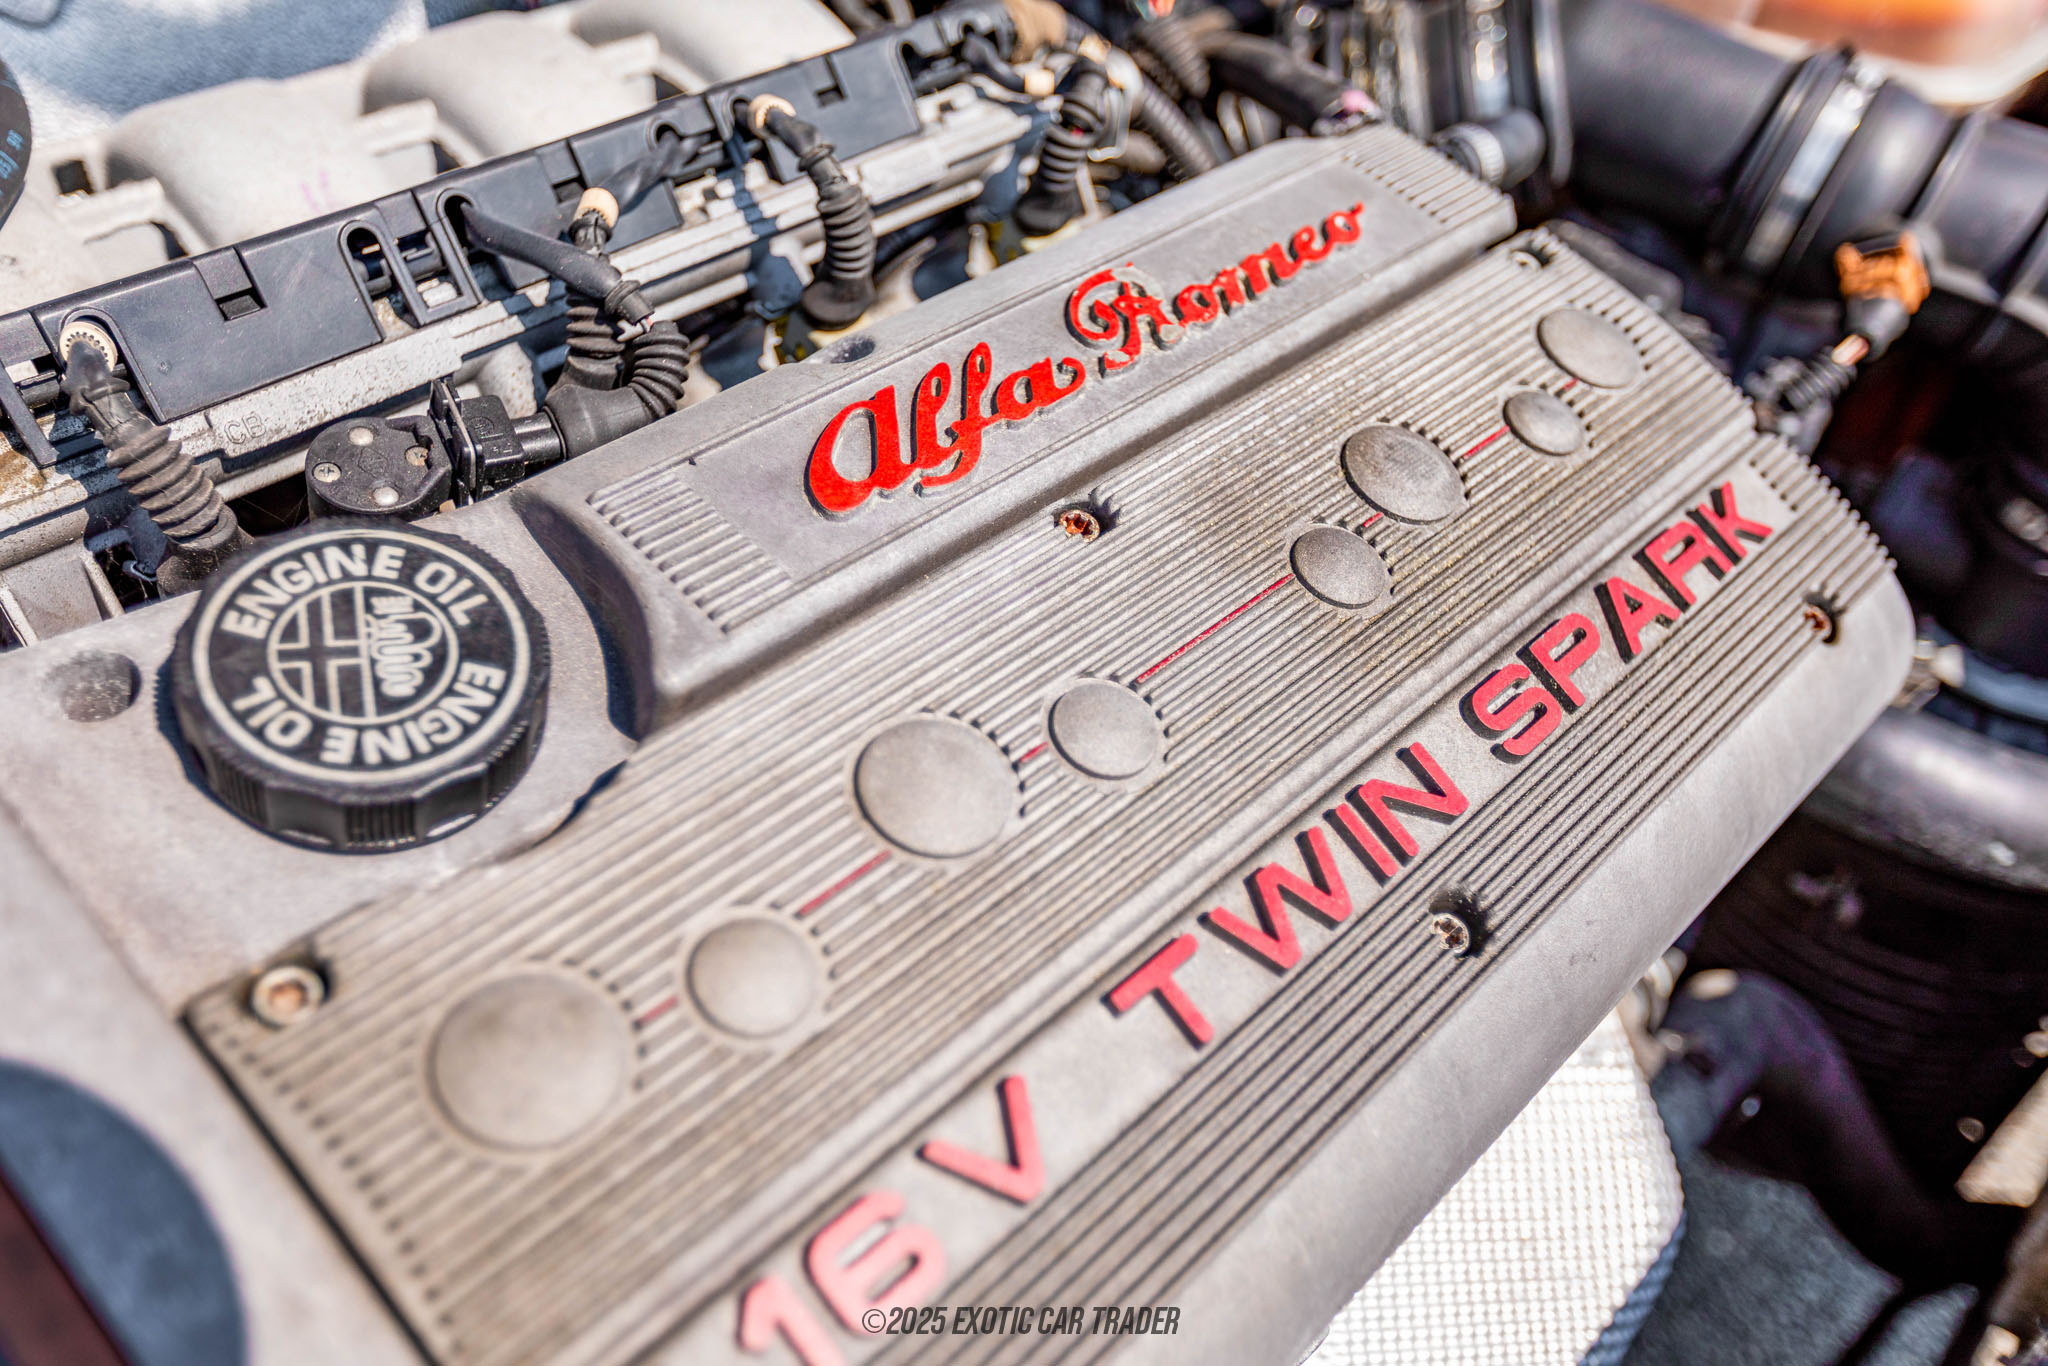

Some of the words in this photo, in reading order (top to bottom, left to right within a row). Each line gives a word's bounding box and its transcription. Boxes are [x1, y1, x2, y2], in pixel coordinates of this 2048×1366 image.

[806, 341, 1086, 512] Alfa
[1067, 202, 1364, 370] Romeo
[220, 543, 407, 640] ENGINE
[414, 561, 489, 627] OIL
[231, 675, 313, 749] OIL
[319, 660, 506, 766] ENGINE
[1108, 741, 1470, 1045] TWIN
[1469, 481, 1773, 757] SPARK
